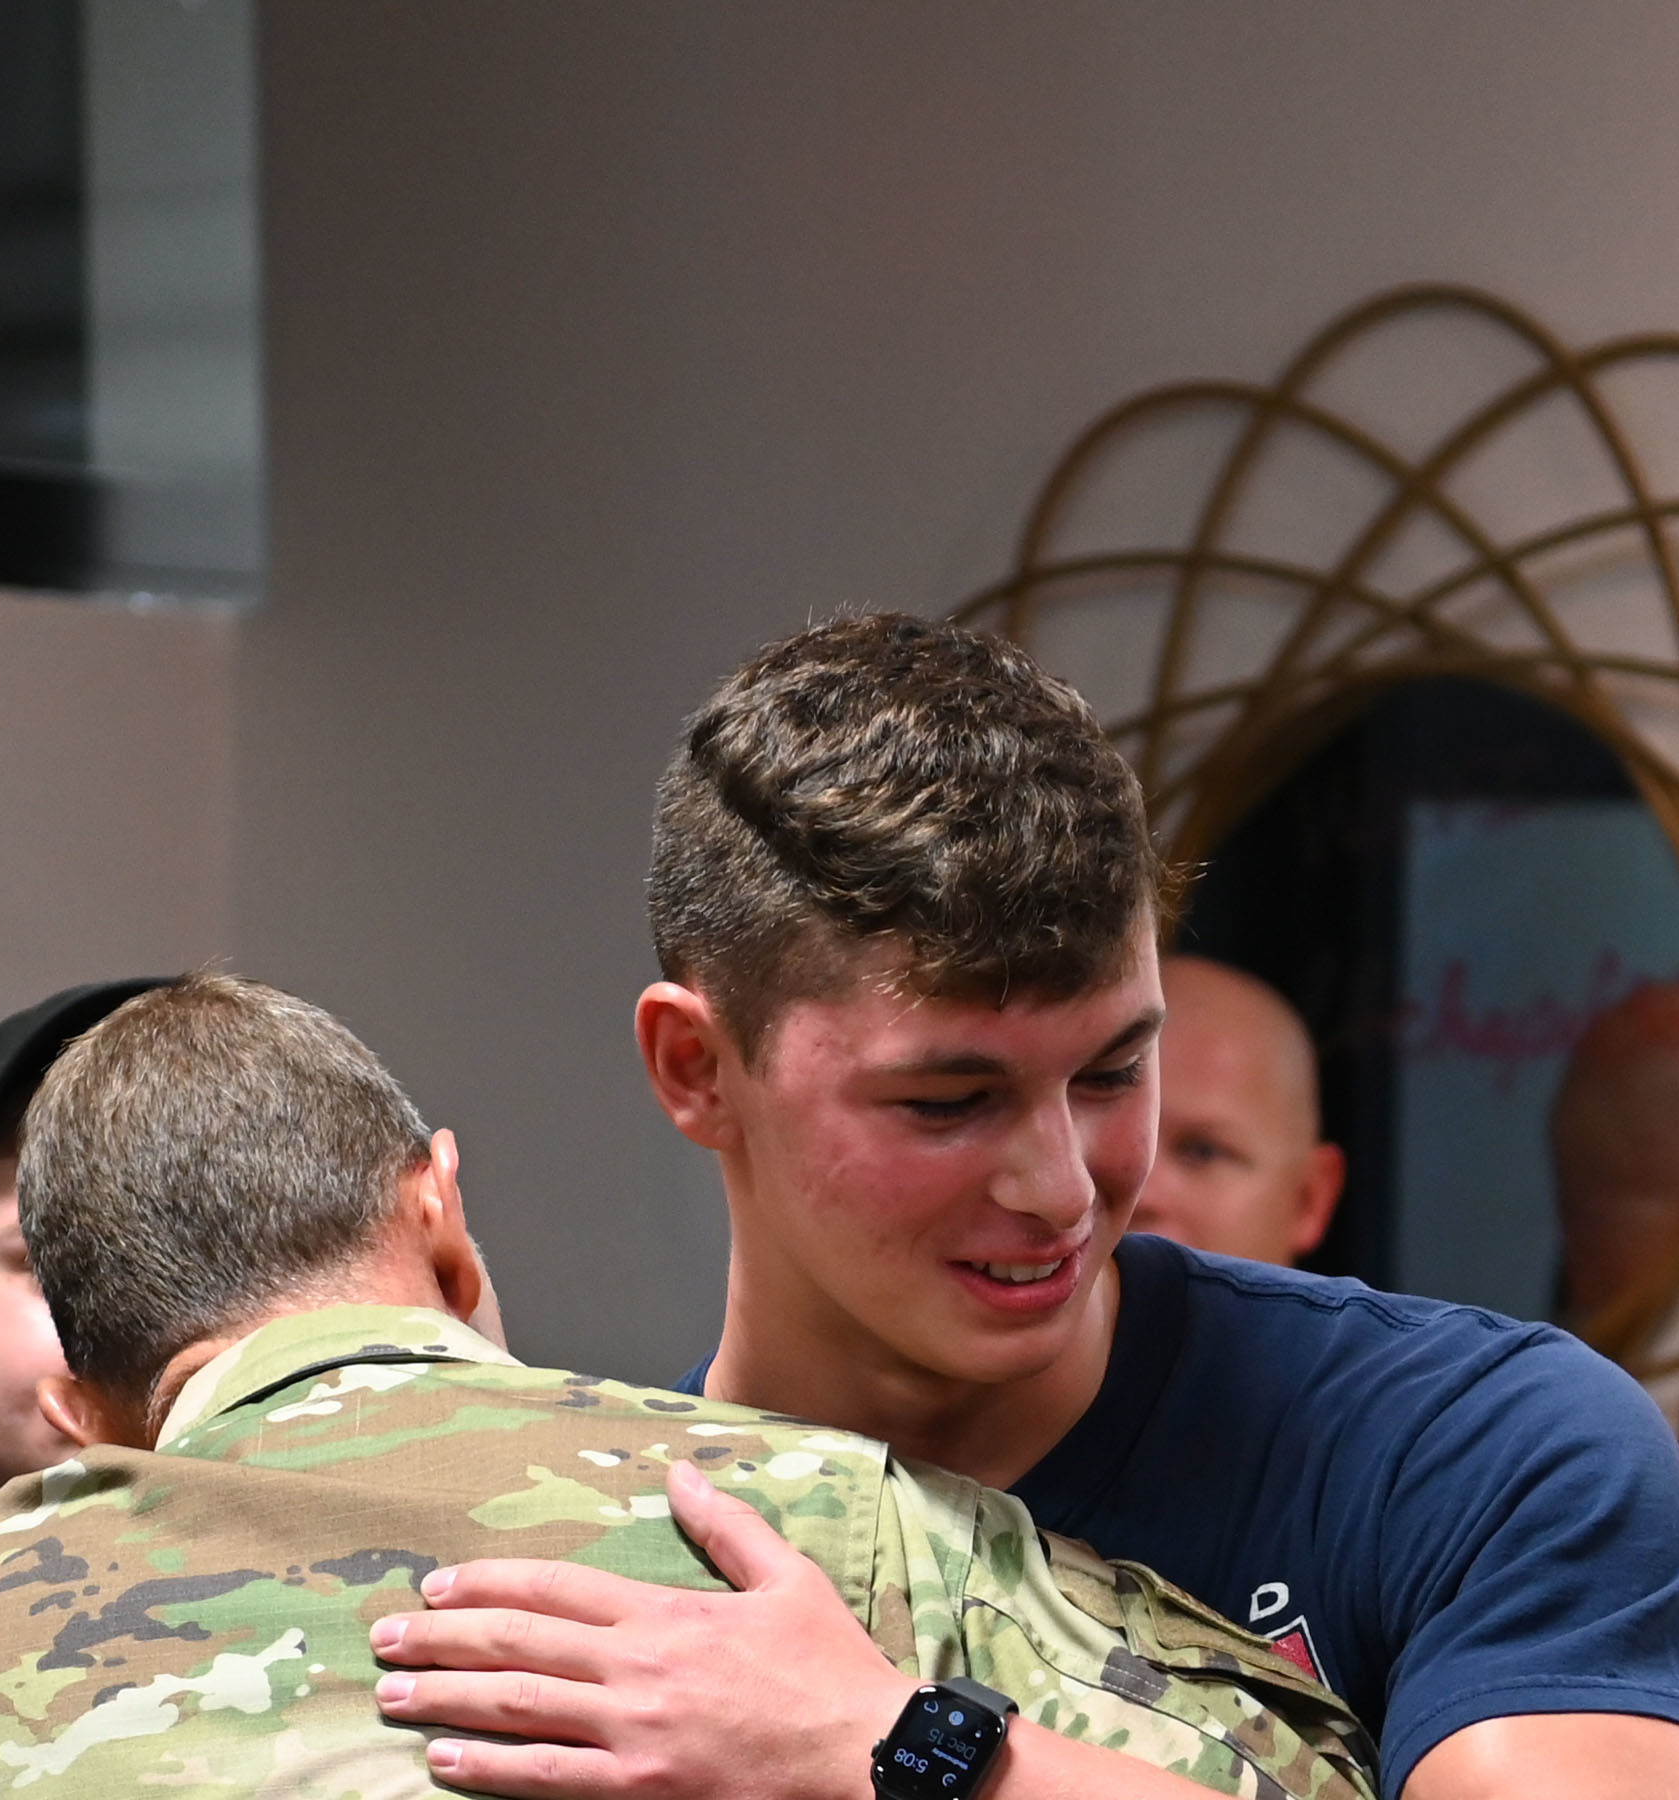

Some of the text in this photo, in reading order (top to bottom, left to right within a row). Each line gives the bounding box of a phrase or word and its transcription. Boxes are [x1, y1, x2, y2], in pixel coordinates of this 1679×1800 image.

[928, 1728, 944, 1745] 15
[894, 1748, 928, 1773] 5:08
[947, 1737, 977, 1761] Dec
